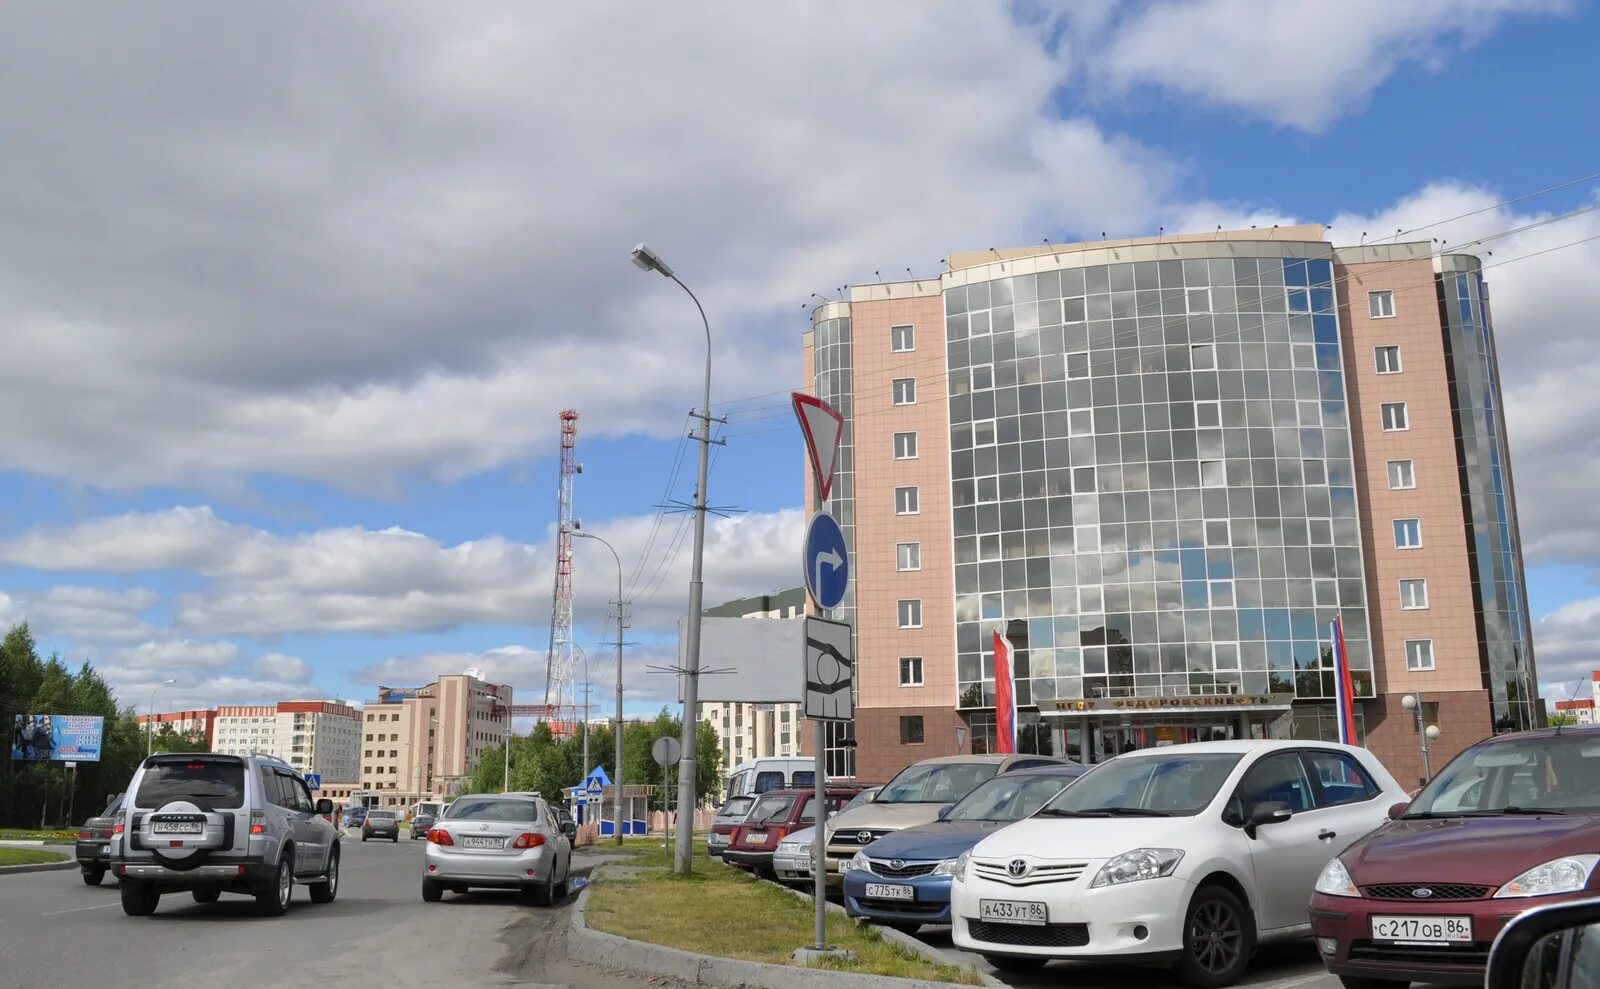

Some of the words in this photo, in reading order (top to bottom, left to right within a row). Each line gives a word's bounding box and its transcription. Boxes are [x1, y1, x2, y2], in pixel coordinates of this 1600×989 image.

[985, 903, 1027, 918] А433УТ
[1030, 904, 1042, 915] 86
[1378, 920, 1442, 938] С217ОВ
[1447, 919, 1464, 933] 86
